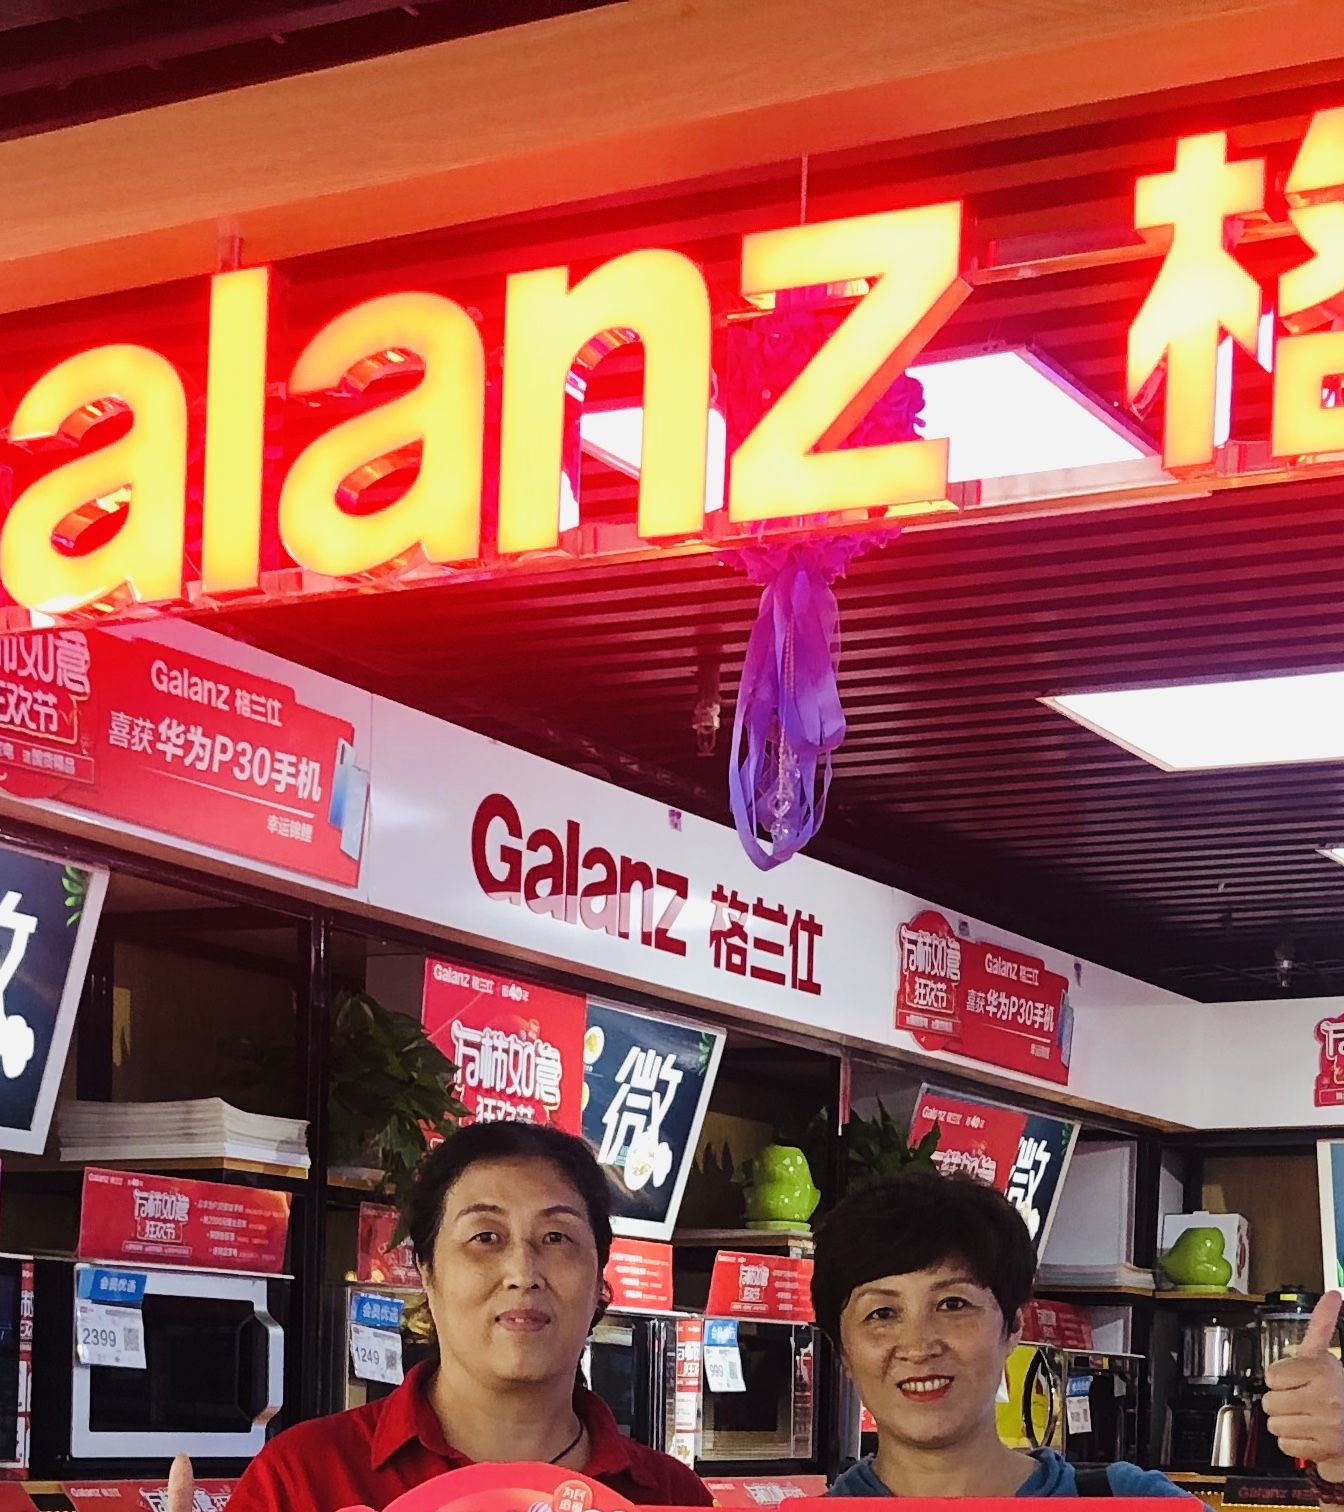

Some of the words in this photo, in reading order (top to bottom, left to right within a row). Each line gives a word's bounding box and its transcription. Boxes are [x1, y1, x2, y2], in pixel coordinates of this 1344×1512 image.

[151, 660, 231, 711] Galanz
[234, 688, 283, 728] 格兰仕
[108, 709, 322, 803] 喜获华为P30手机
[471, 793, 688, 958] Galanz
[709, 883, 824, 996] 格兰仕
[433, 963, 471, 990] Galanz
[984, 952, 1018, 982] Galanz
[913, 975, 948, 1010] 狂欢节
[598, 1046, 684, 1165] 微
[144, 1221, 176, 1241] 狂欢节
[99, 1276, 137, 1294] 会员优选
[362, 1301, 400, 1323] 会员优选
[82, 1327, 117, 1348] 2399
[354, 1346, 380, 1366] 1249
